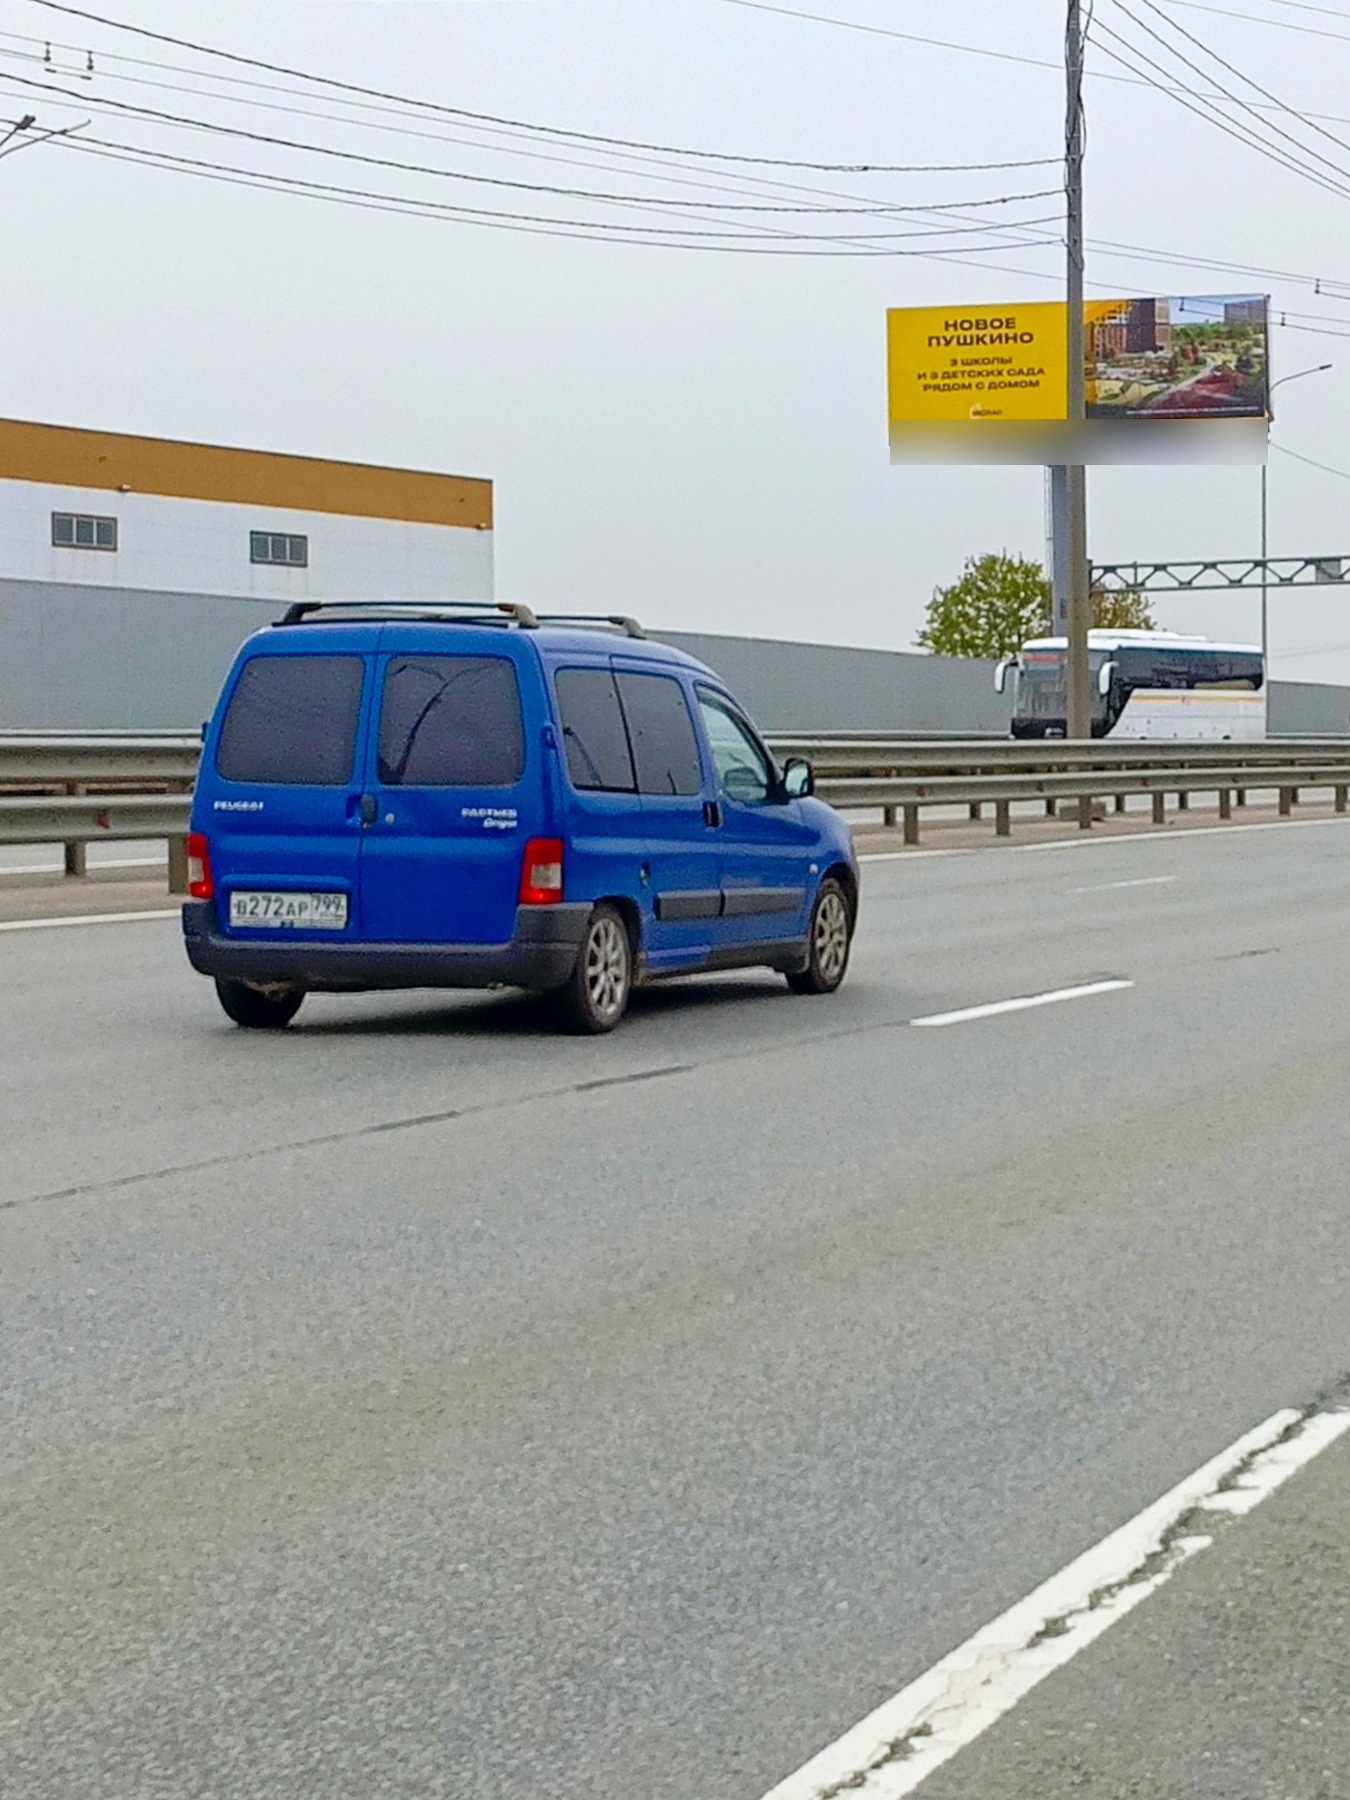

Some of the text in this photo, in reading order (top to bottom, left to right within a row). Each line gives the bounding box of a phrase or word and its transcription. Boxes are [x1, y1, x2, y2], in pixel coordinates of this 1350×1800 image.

[944, 317, 1017, 332] НОВОЕ
[927, 332, 1034, 348] ПУШКИНО
[949, 356, 1013, 367] 3 ШКОЛЫ
[917, 367, 1046, 381] И 3 ДЕТСКИХ САДА
[922, 379, 1040, 392] РЯДОМ С ДОМОМ
